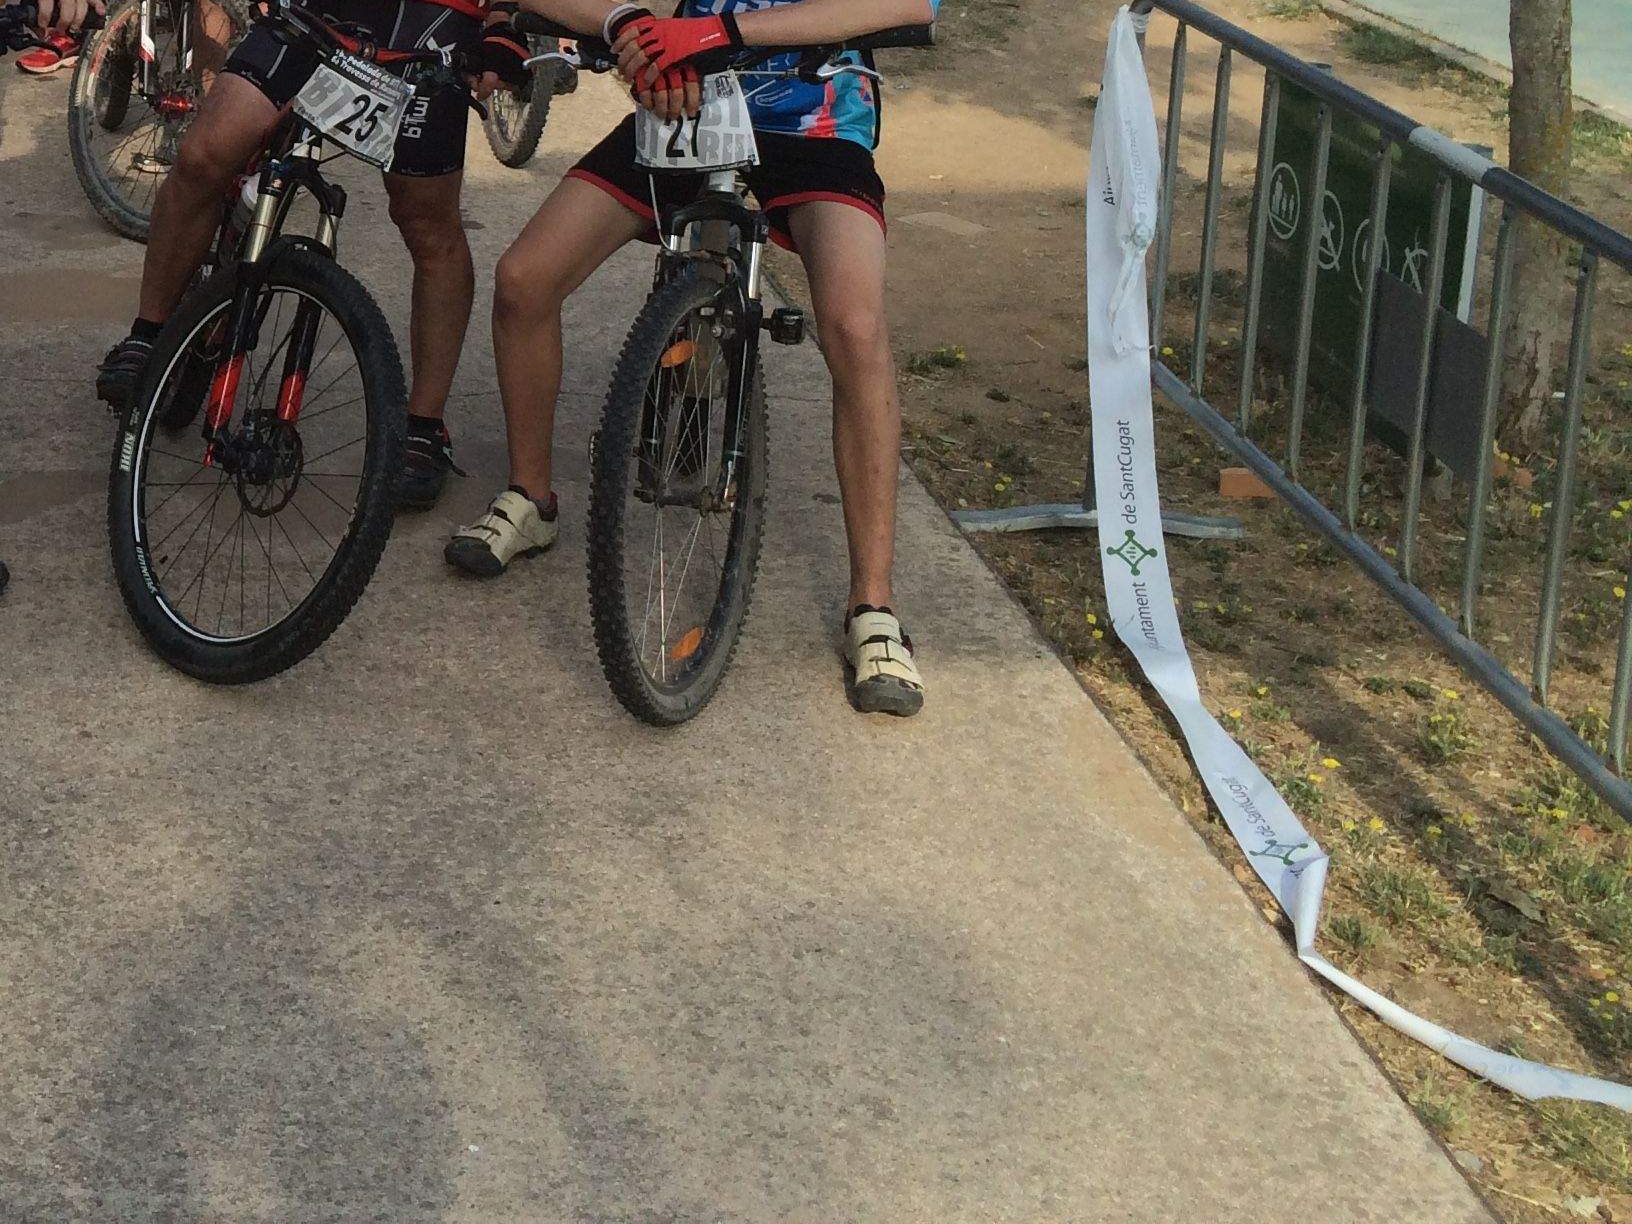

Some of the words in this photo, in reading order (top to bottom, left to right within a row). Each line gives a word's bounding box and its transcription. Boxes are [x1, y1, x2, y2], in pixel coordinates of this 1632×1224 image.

[340, 60, 371, 83] Travessa
[334, 94, 389, 142] 25
[1116, 419, 1138, 504] SantCugat
[1121, 505, 1137, 525] de
[1132, 581, 1160, 651] juntament
